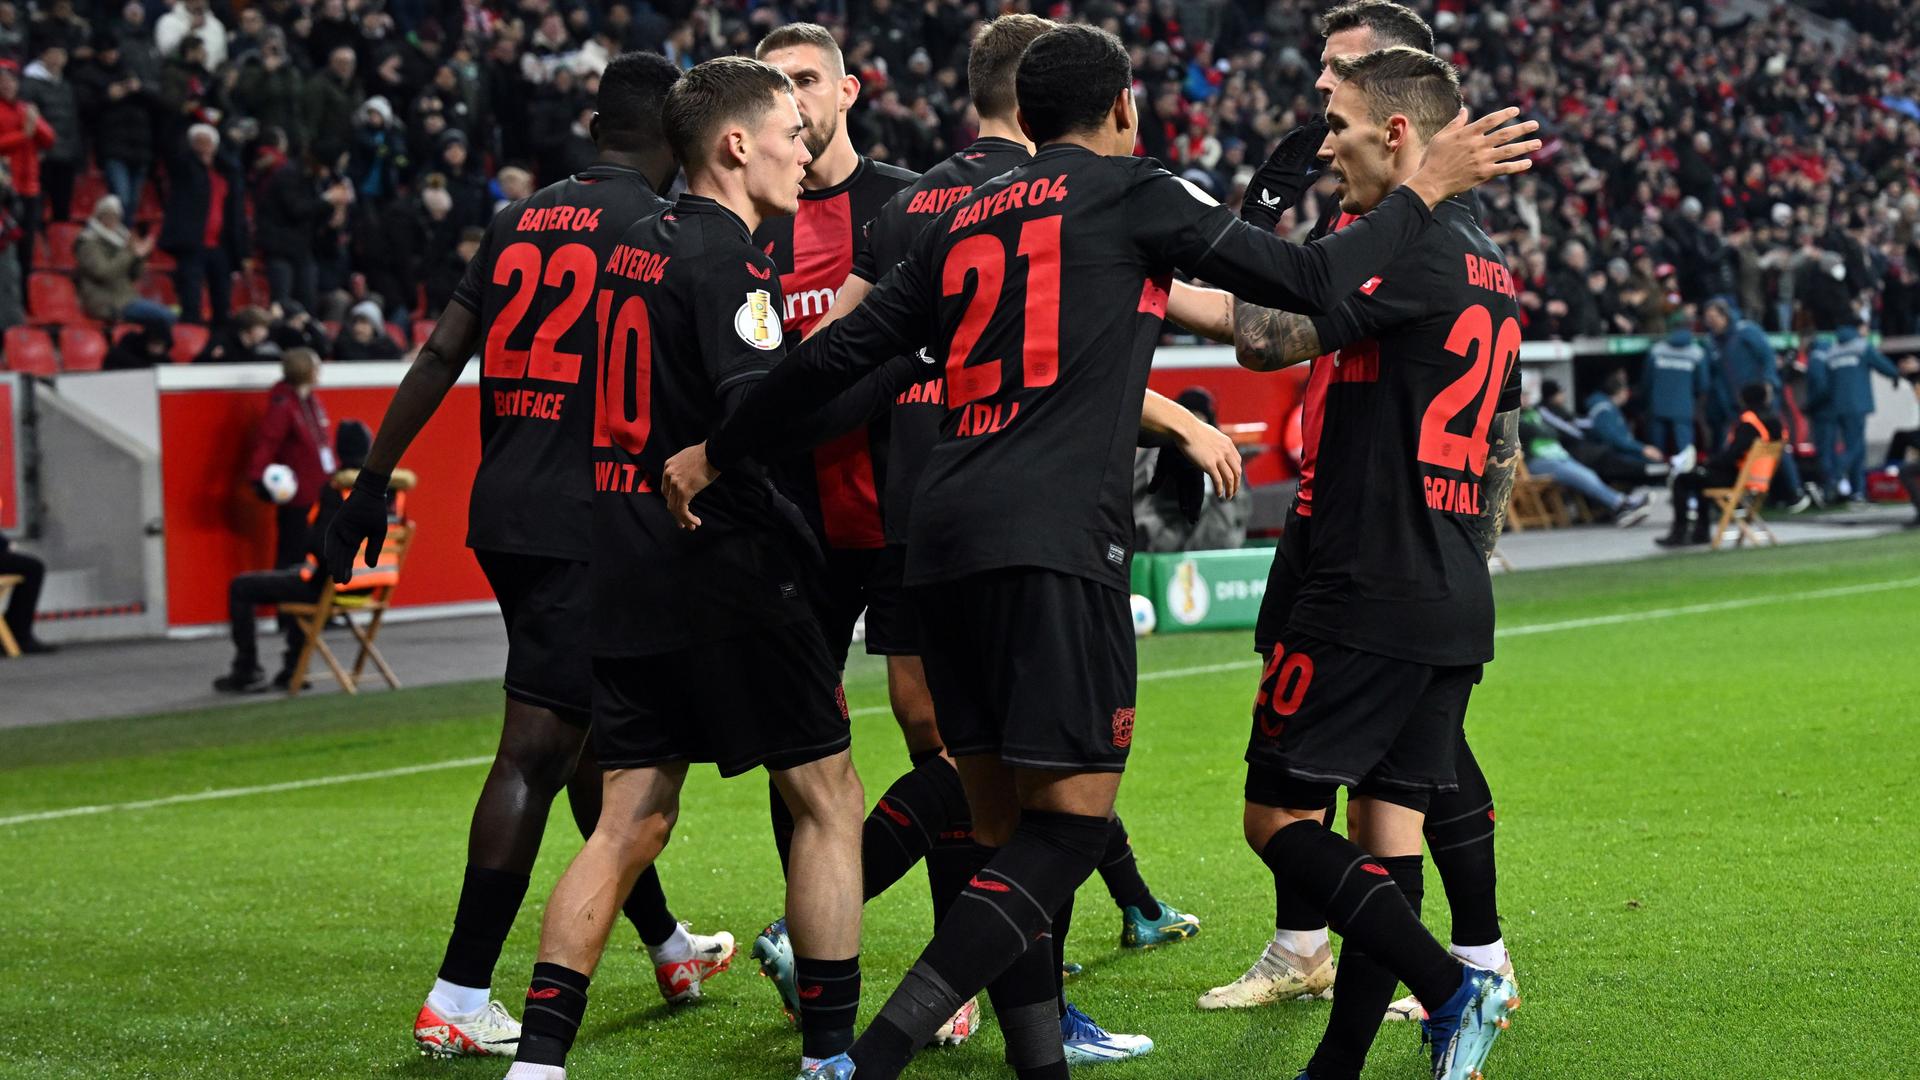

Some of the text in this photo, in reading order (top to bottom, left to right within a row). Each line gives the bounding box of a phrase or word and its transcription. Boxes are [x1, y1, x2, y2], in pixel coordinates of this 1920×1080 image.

[484, 241, 598, 384] 22
[593, 289, 651, 455] 10
[783, 287, 844, 320] rm
[942, 214, 1062, 410] 21
[1417, 304, 1522, 477] 20
[1257, 642, 1314, 716] 20
